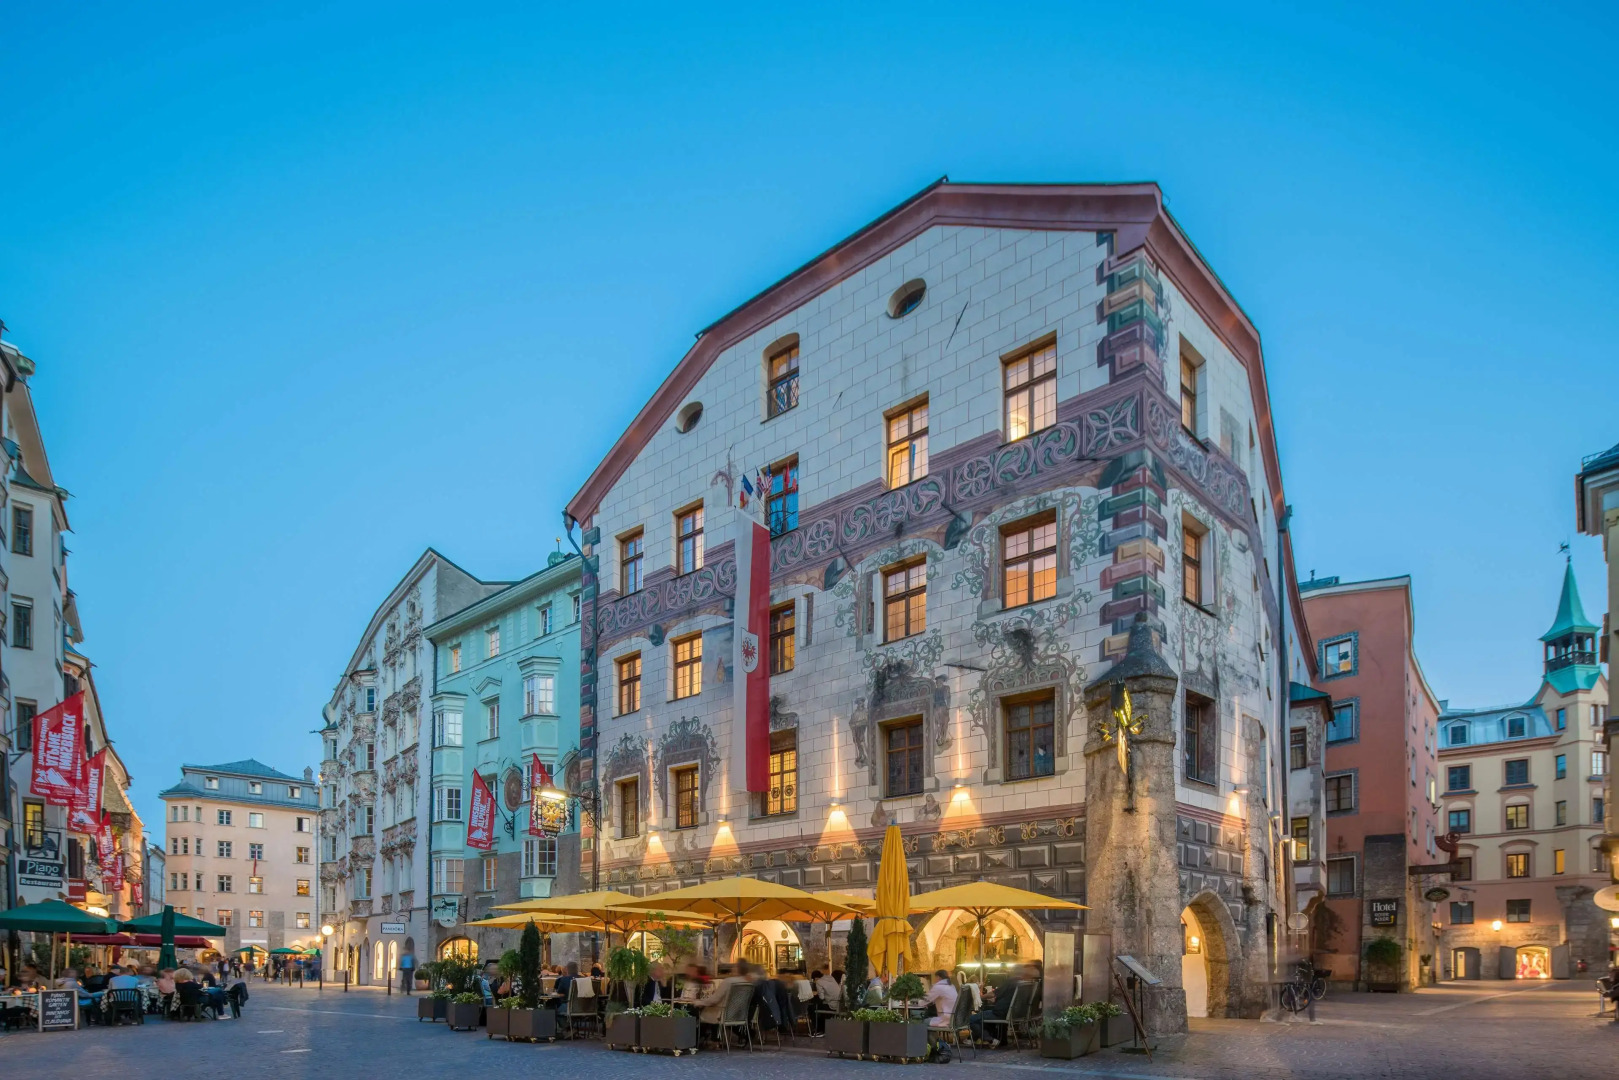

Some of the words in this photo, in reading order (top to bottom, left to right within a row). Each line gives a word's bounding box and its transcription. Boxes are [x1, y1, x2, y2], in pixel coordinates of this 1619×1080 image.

[471, 788, 482, 827] INNSBRUCK
[478, 804, 486, 828] ALPINE
[26, 861, 59, 874] Piano
[21, 879, 61, 887] Restaurant
[1372, 902, 1396, 911] Hotel
